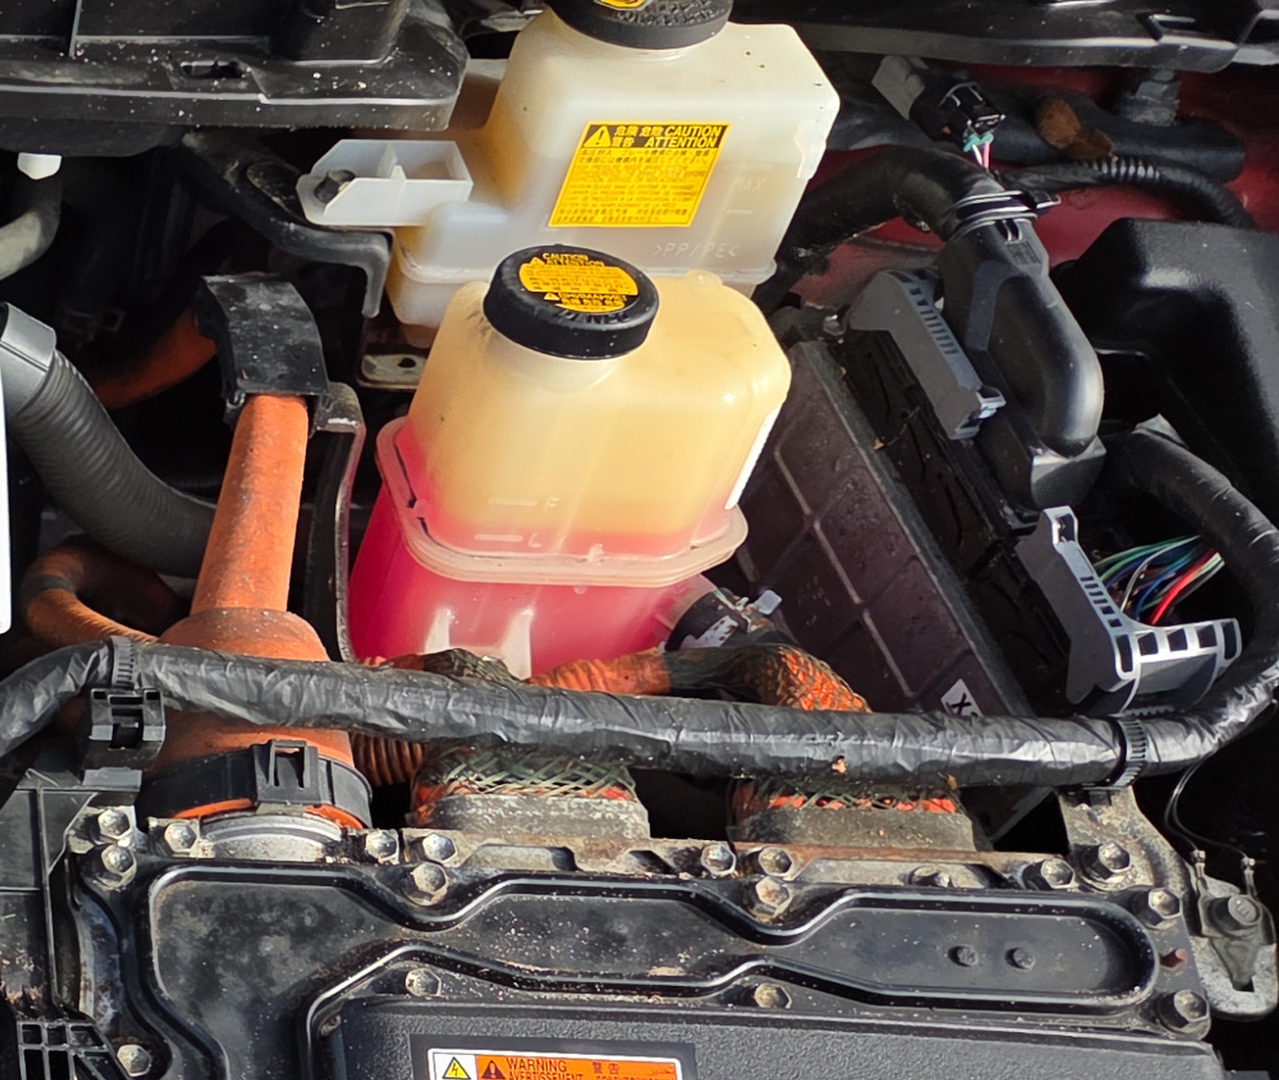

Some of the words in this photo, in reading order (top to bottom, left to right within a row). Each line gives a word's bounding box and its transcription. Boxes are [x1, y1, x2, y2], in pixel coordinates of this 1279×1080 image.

[664, 126, 721, 136] CAUTION
[645, 136, 717, 147] ATTENTION
[506, 1057, 567, 1072] WARNING
